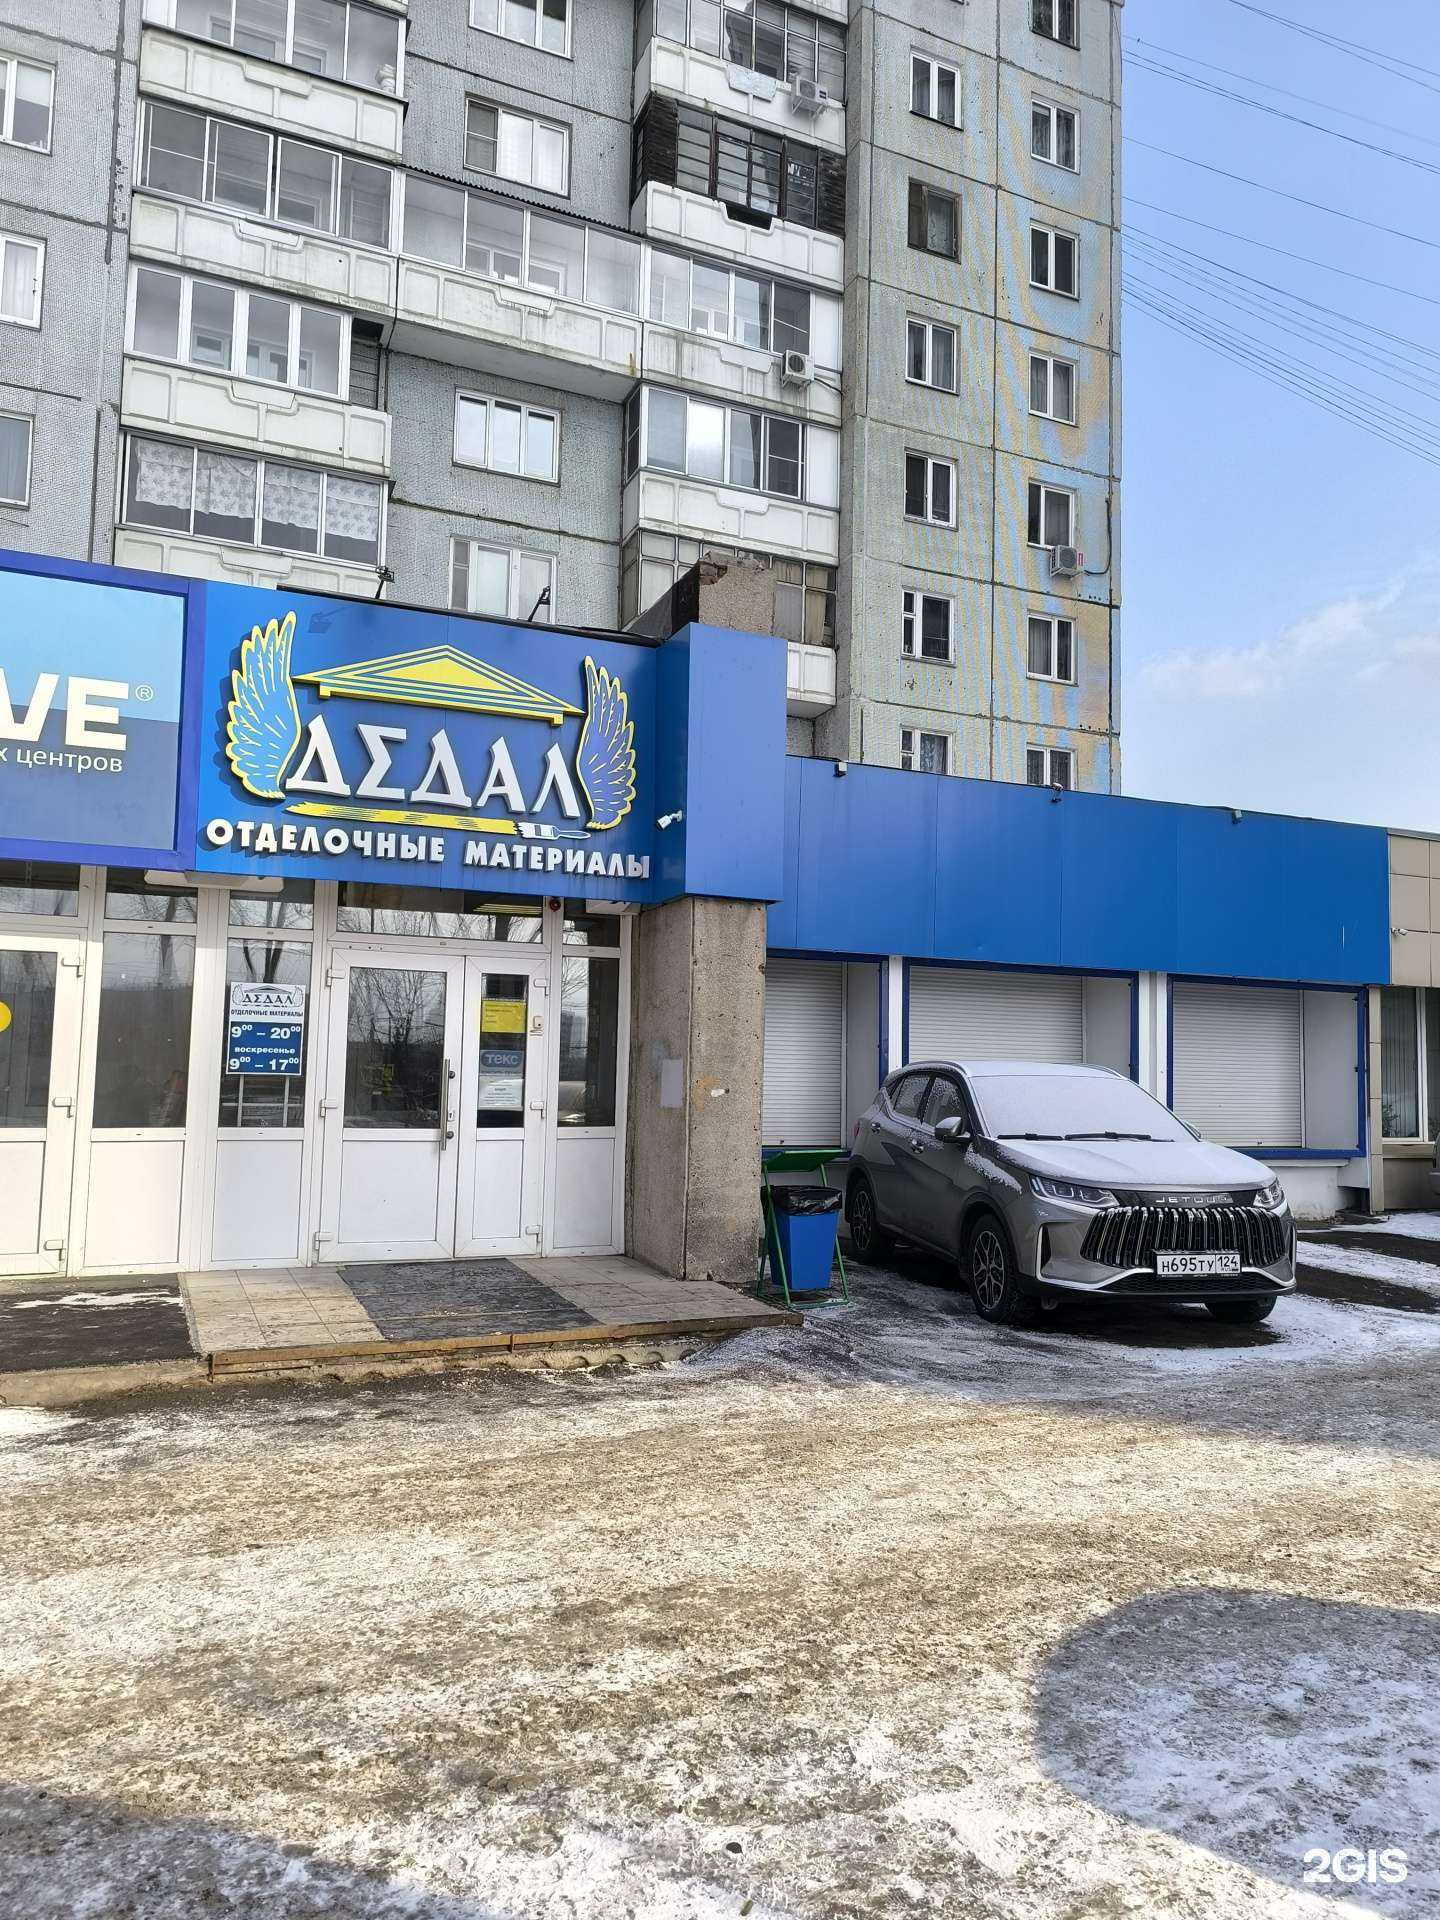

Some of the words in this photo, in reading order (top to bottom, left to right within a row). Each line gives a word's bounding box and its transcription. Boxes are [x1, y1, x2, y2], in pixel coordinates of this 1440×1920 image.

[16, 748, 123, 774] центров
[206, 818, 445, 863] ОТДЕЛОЧНЫЕ
[463, 840, 650, 880] МАТЕРИАЛЫ
[234, 1046, 296, 1054] воскресенье
